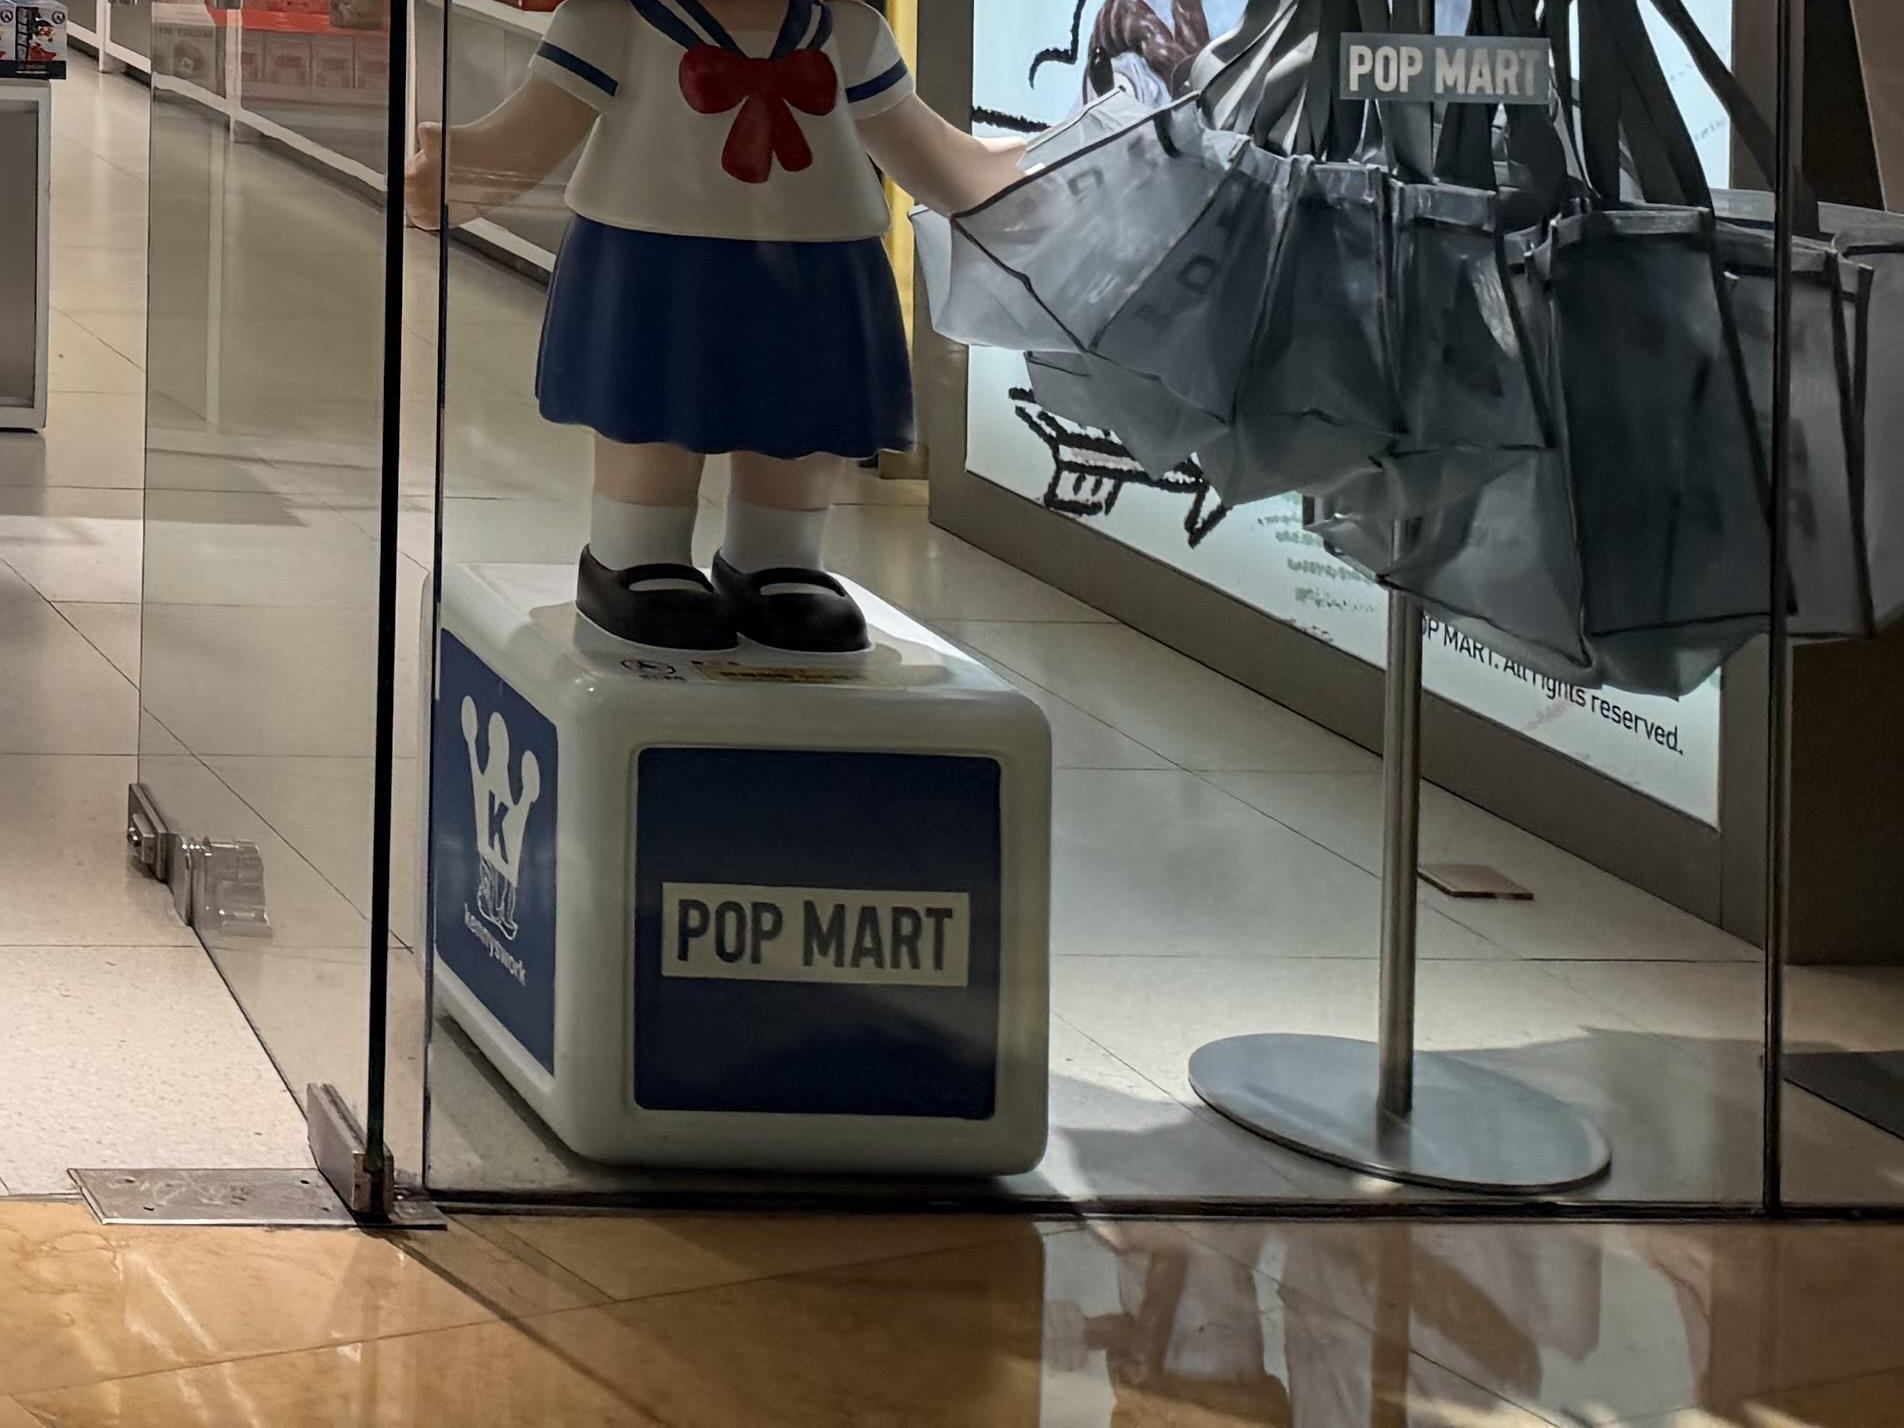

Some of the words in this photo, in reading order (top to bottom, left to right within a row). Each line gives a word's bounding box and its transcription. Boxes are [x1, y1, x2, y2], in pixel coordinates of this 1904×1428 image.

[1349, 44, 1424, 93] POP
[1434, 47, 1539, 96] MART
[1590, 692, 1684, 757] reserved.
[677, 898, 784, 966] POP
[801, 899, 955, 972] MART
